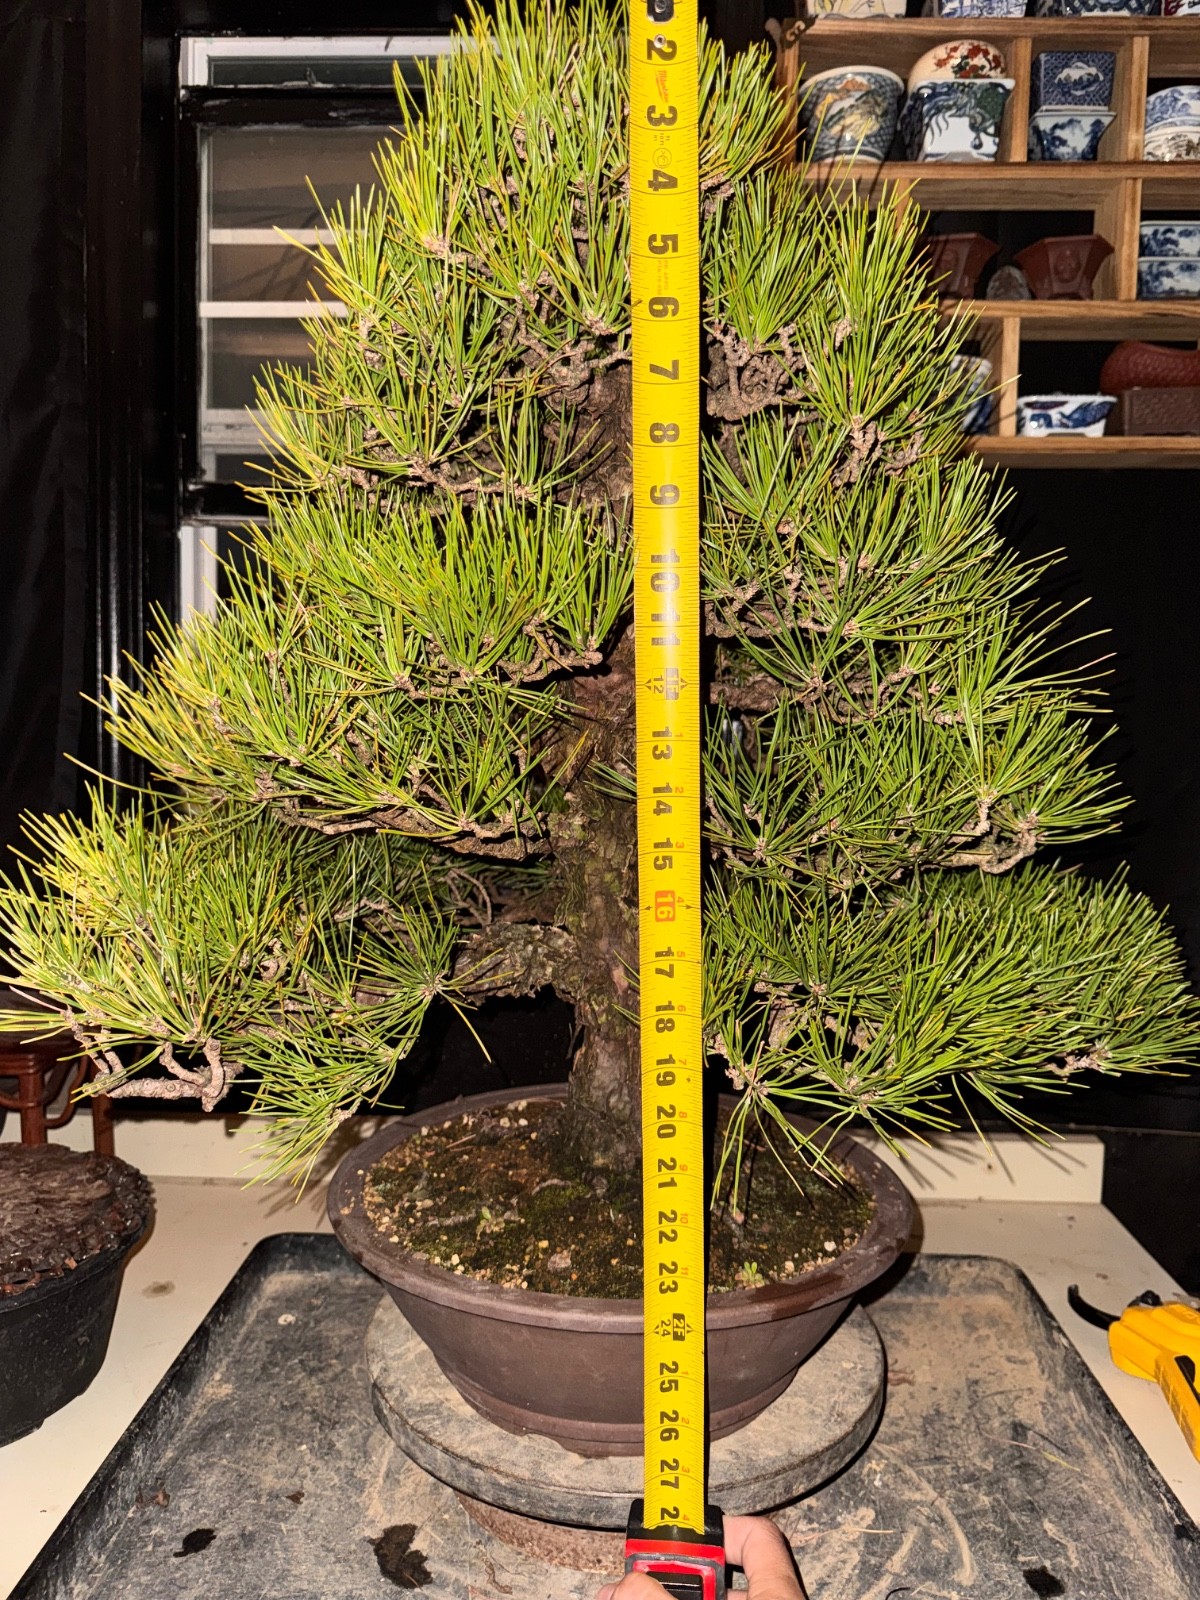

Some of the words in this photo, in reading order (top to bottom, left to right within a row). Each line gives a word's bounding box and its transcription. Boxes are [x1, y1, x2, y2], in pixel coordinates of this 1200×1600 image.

[647, 38, 677, 61] 2
[647, 105, 677, 126] 3
[648, 169, 678, 191] 4
[648, 233, 678, 254] 5
[648, 296, 680, 318] 6
[650, 360, 679, 380] 7
[649, 422, 680, 443] 8
[650, 484, 680, 505] 9
[650, 548, 680, 592] 10
[651, 608, 680, 646] 11
[653, 675, 666, 694] 12
[652, 725, 672, 760] 13
[653, 782, 672, 816] 14
[653, 838, 673, 870] 15
[656, 894, 674, 919] 16
[655, 946, 674, 978] 17
[655, 1001, 675, 1033] 18
[656, 1054, 676, 1086] 19
[657, 1104, 676, 1138] 20
[658, 1157, 677, 1188] 21
[658, 1210, 678, 1244] 22
[680, 1213, 688, 1224] 10
[659, 1261, 678, 1294] 23
[680, 1267, 688, 1275] 11
[661, 1319, 671, 1336] 24
[673, 1318, 685, 1337] 2F
[660, 1361, 678, 1392] 25
[660, 1410, 679, 1441] 26
[660, 1458, 679, 1489] 27
[661, 1506, 679, 1527] 2
